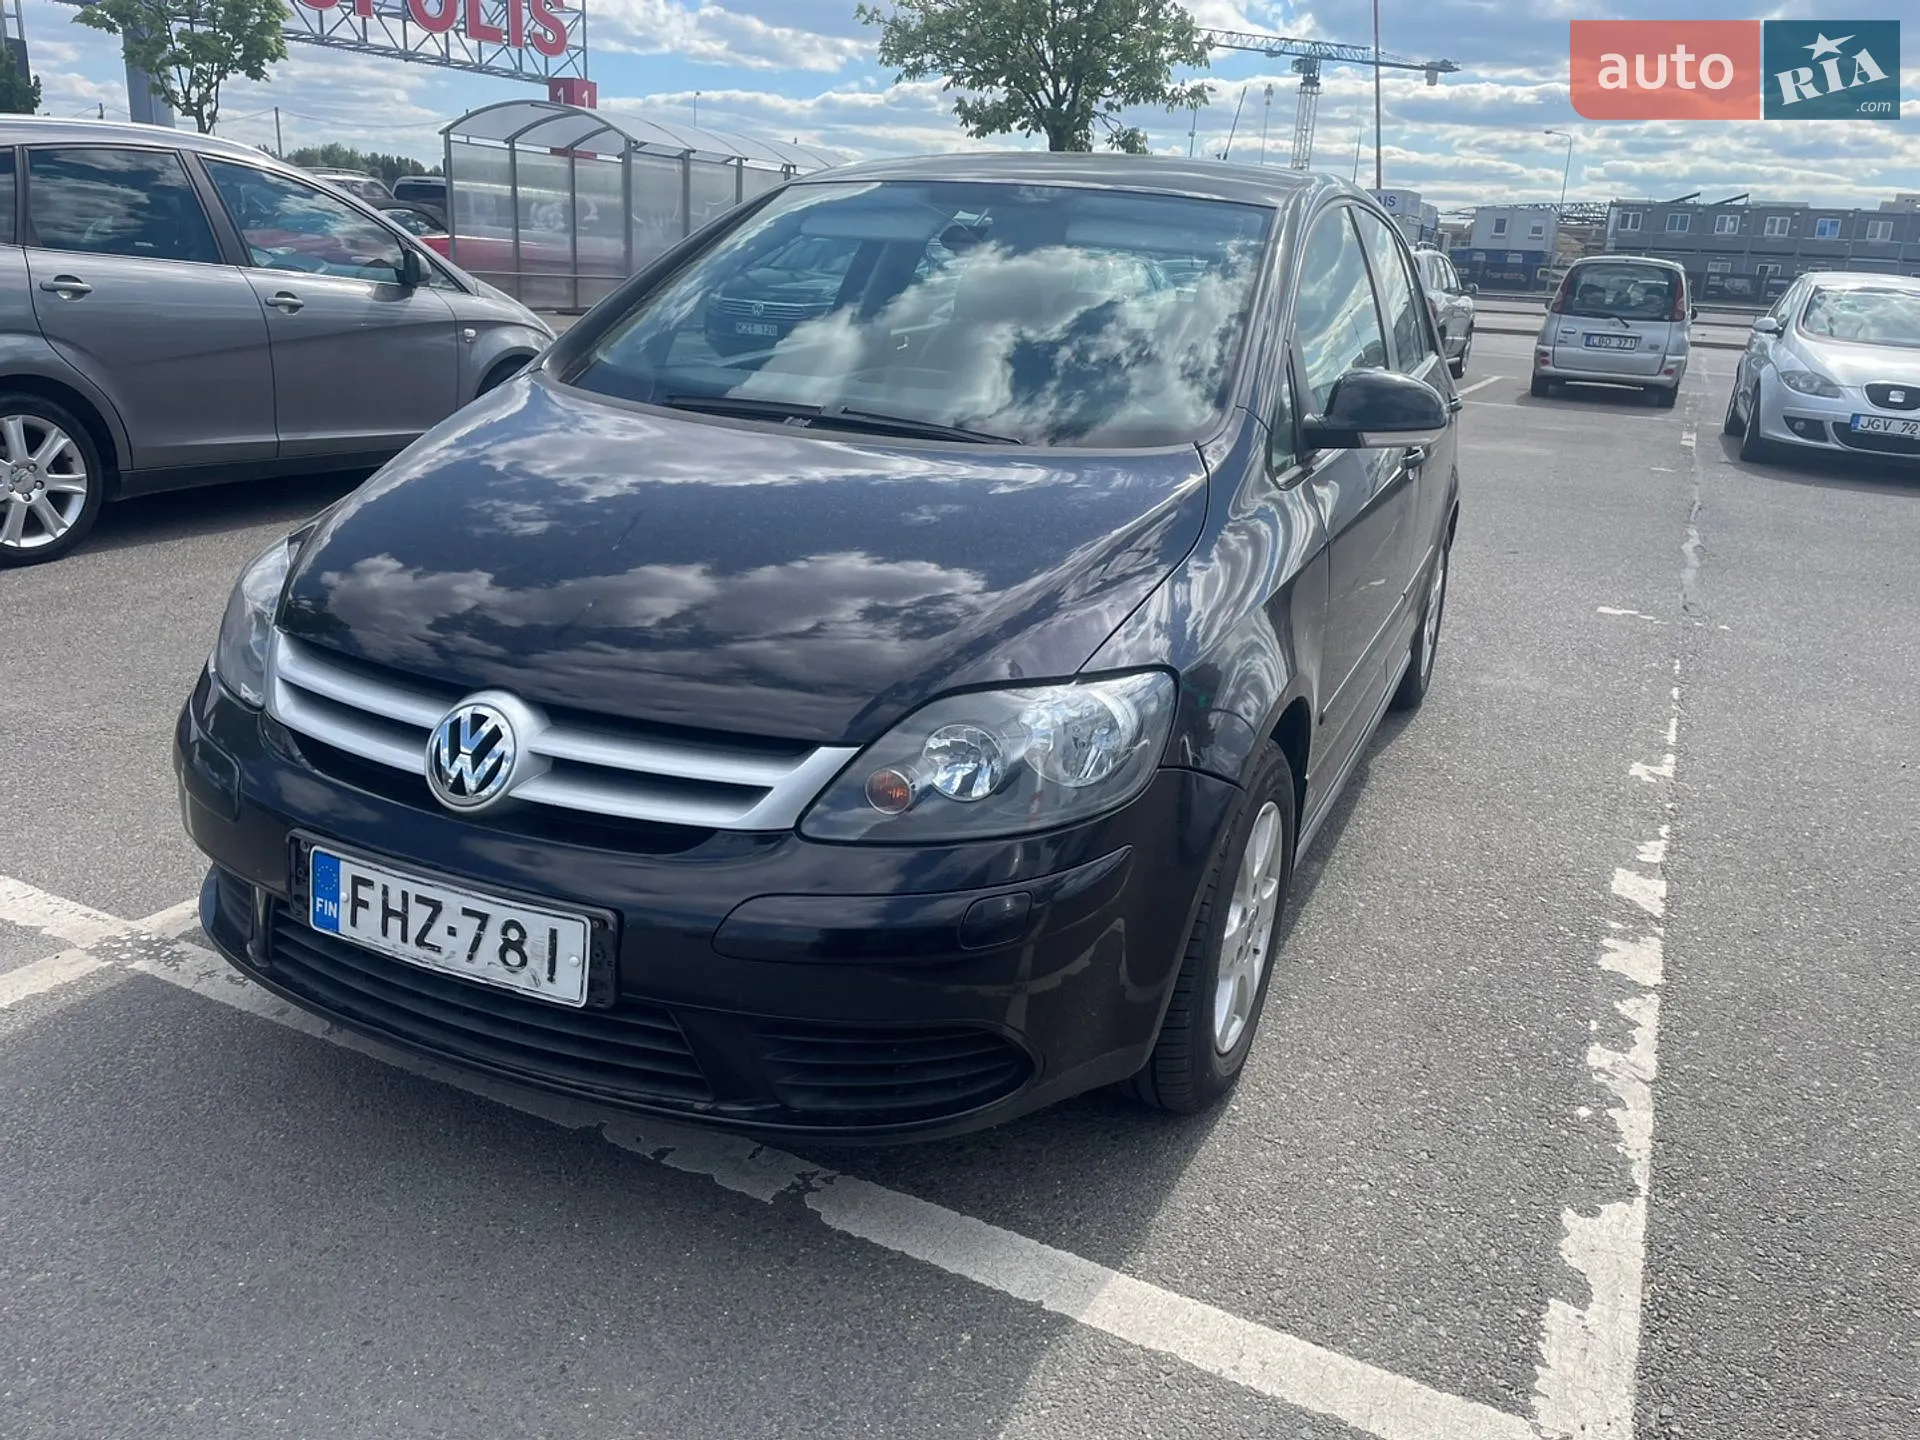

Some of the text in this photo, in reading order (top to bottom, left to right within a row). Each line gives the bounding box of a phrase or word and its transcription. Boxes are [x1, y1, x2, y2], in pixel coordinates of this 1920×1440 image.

[1860, 417, 1893, 431] JGV
[315, 896, 338, 919] FIN
[349, 873, 559, 984] FHZ-781
